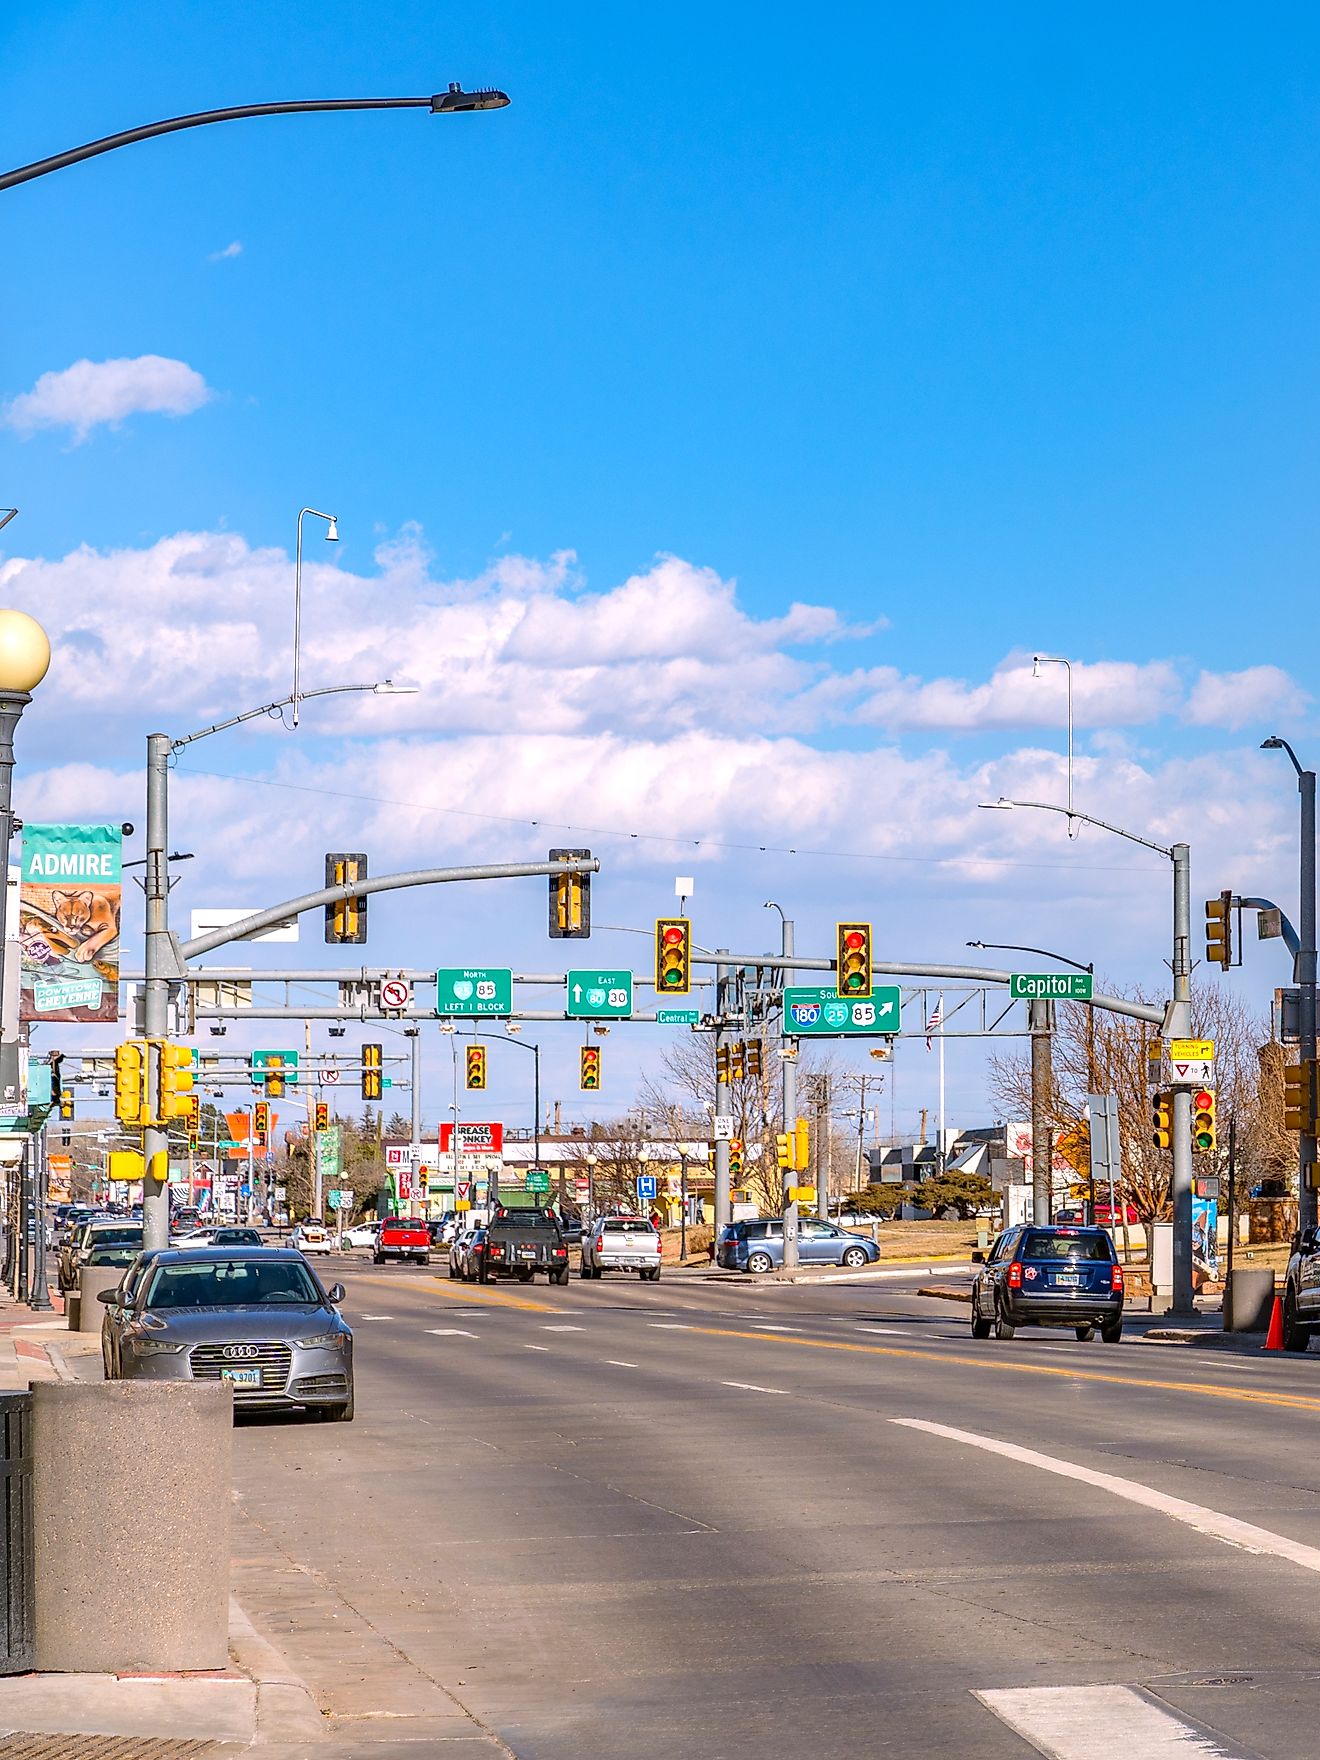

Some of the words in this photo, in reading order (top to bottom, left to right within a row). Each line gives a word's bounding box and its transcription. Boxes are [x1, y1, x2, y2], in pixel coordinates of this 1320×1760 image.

[29, 853, 113, 876] ADMIRE
[38, 981, 100, 999] DOWNTOWN
[478, 985, 494, 995] 85
[1016, 975, 1072, 998] Capitol
[37, 990, 100, 1009] CHEYENNE
[589, 993, 602, 1003] 80
[610, 992, 626, 1003] 30
[444, 1003, 465, 1011] LEFT
[477, 1003, 505, 1011] BLOCK
[659, 1011, 688, 1023] Central
[794, 1009, 818, 1023] 180
[828, 1010, 844, 1022] 25
[854, 1008, 873, 1020] 85
[453, 1126, 490, 1135] GREASE
[463, 1135, 491, 1143] ONKEY
[239, 1373, 257, 1382] 9701
